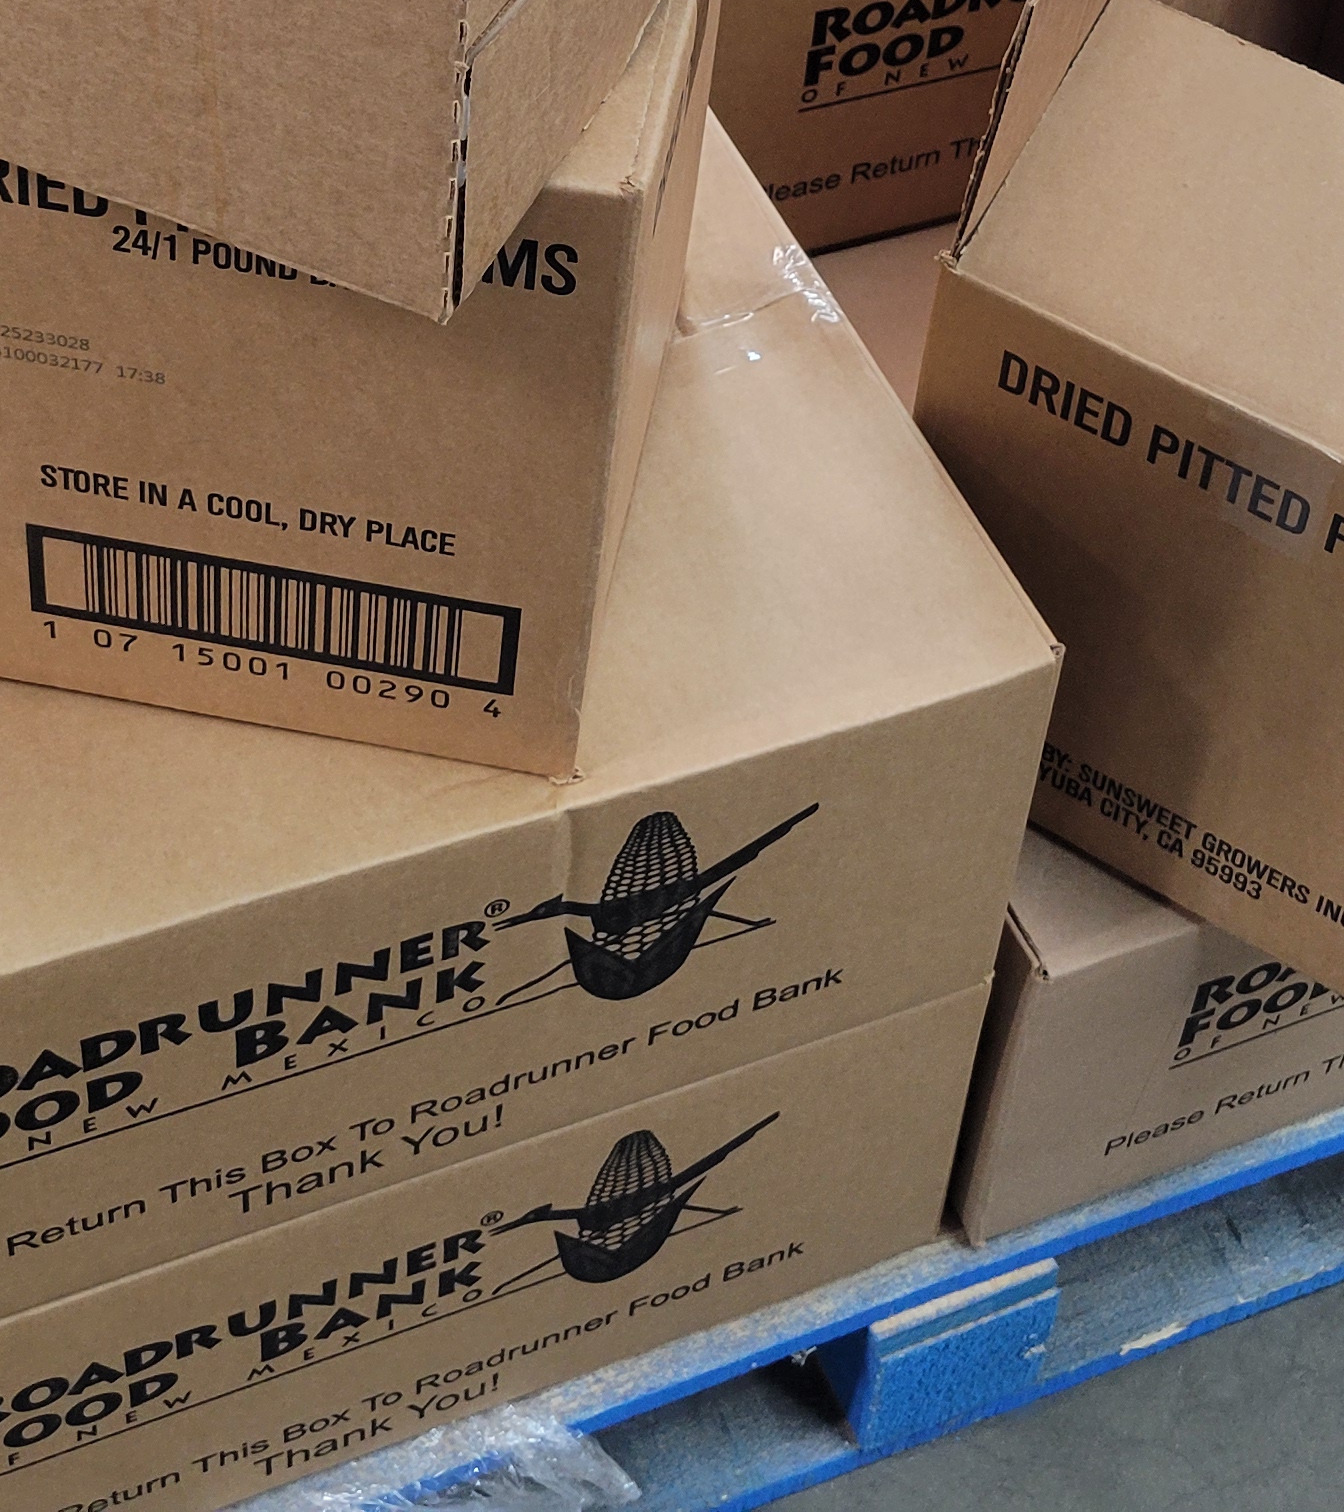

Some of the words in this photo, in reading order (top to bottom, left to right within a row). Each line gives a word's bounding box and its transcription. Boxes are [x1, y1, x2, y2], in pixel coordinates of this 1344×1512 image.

[803, 24, 964, 87] FOOD
[763, 173, 841, 203] lease
[850, 151, 940, 184] Return
[112, 225, 178, 261] 24/1
[0, 324, 90, 351] 25233028
[117, 365, 166, 385] 17:38
[997, 349, 1133, 447] DRIED
[1146, 424, 1311, 534] PITTED
[40, 464, 128, 501] STORE
[139, 480, 168, 507] IN
[177, 488, 197, 513] A
[207, 493, 288, 532] COOL,
[299, 509, 356, 539] DRY
[365, 518, 456, 556] PLACE
[43, 620, 57, 639] 1
[93, 628, 138, 652] 07
[172, 642, 290, 681] 15001
[326, 670, 450, 709] 00290
[483, 698, 502, 718] 4
[1039, 766, 1092, 807] YUBA
[1100, 797, 1149, 841] CITY,
[1157, 829, 1184, 858] CA
[1191, 849, 1262, 900] 95993
[1079, 764, 1197, 840] SUNSWEET
[1202, 833, 1310, 905] GROWERS
[235, 960, 486, 1069] BANK
[7, 1198, 146, 1256] Return
[160, 1165, 246, 1205] This
[261, 1136, 337, 1174] Box
[350, 1116, 396, 1141] To
[410, 1035, 639, 1124] Roadrunner
[647, 999, 739, 1045] Food
[753, 968, 844, 1011] Bank
[27, 1098, 158, 1151] NEW
[221, 995, 485, 1090] MEXICO
[1104, 1109, 1204, 1156] Please
[1214, 1070, 1309, 1115] Return
[229, 1149, 384, 1215] Thank
[401, 1104, 504, 1155] You!
[192, 1434, 270, 1473] This
[283, 1408, 351, 1443] Box
[364, 1389, 403, 1412] To
[415, 1309, 619, 1394] Roadrunner
[629, 1272, 711, 1317] Food
[722, 1240, 804, 1283] Bank
[259, 1261, 483, 1362] BANK
[76, 1391, 192, 1441] NEW
[247, 1289, 484, 1381] MEXICO
[253, 1413, 393, 1476] Thank
[407, 1372, 500, 1419] You!
